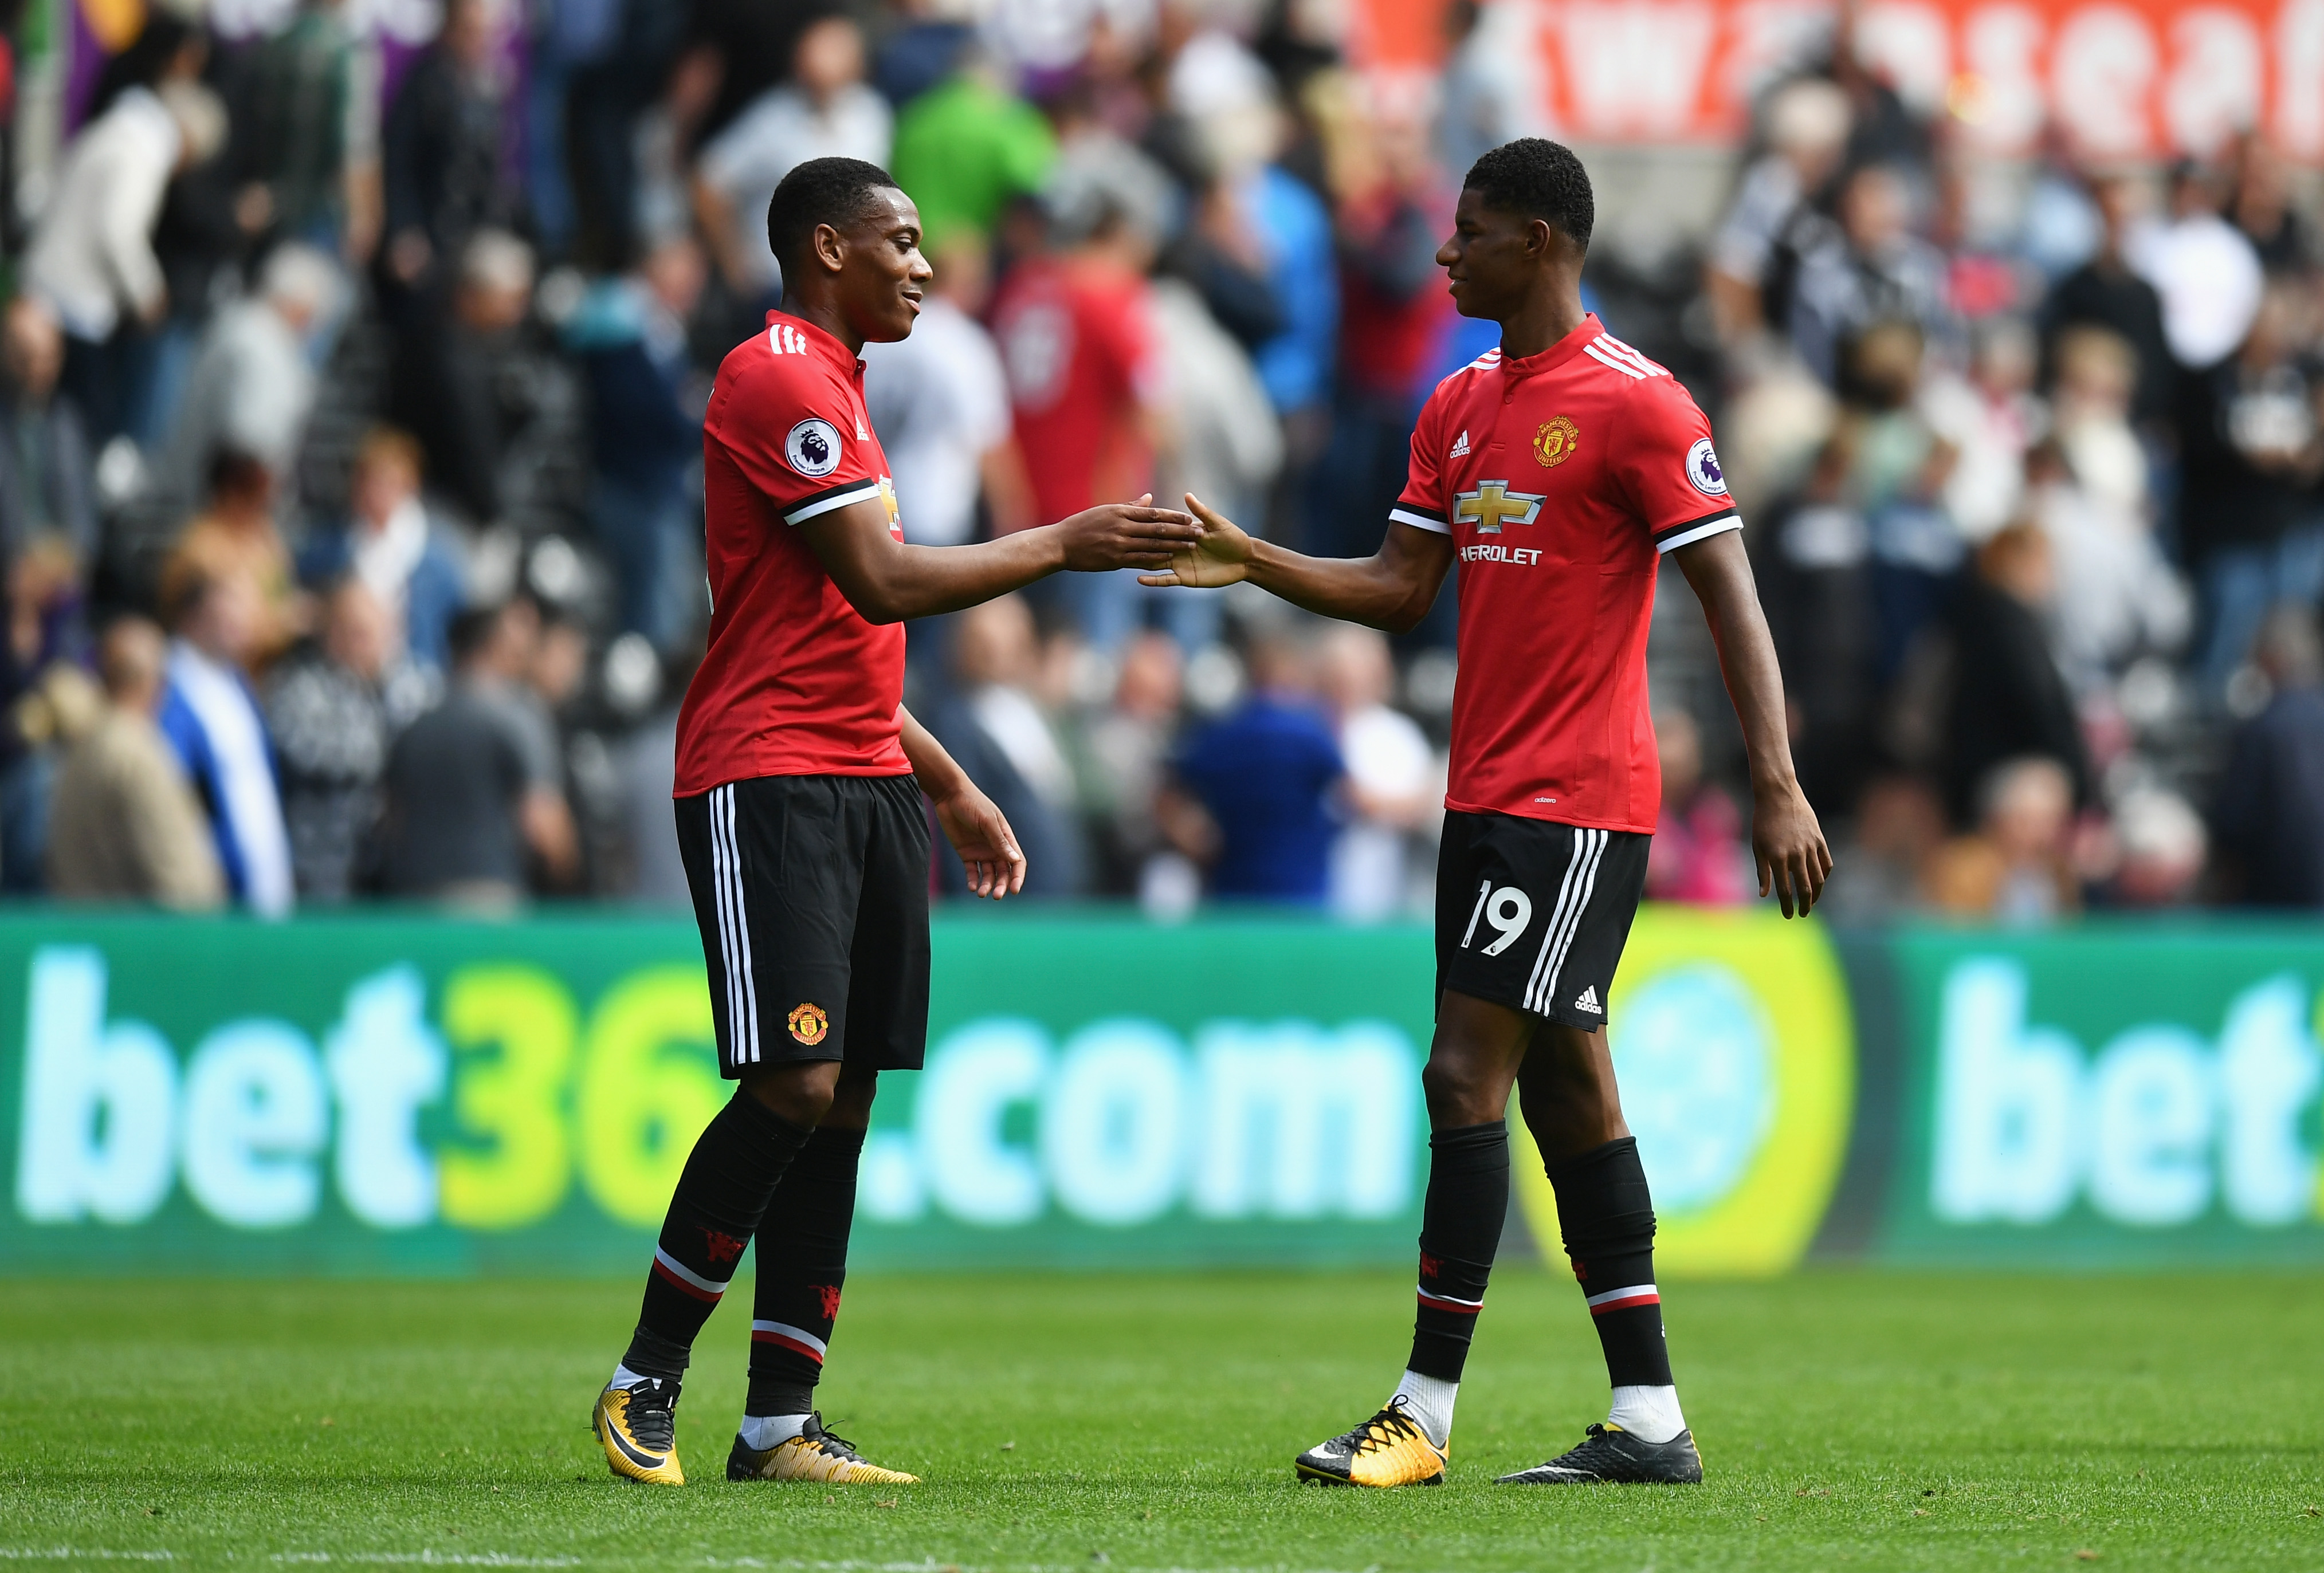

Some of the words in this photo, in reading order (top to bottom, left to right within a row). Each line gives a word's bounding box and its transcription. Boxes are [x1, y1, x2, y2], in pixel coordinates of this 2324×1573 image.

[1541, 419, 1575, 438] MANCHESTER
[1450, 446, 1470, 459] adidas
[1538, 453, 1562, 463] UNITED
[1460, 544, 1543, 566] HEROLET
[1461, 879, 1532, 957] 19
[791, 1005, 823, 1020] MANCHESTER
[1575, 1001, 1602, 1014] adidas
[800, 1034, 822, 1043] UNITED
[13, 942, 1418, 1232] bet36.com
[1926, 954, 2324, 1229] bet
